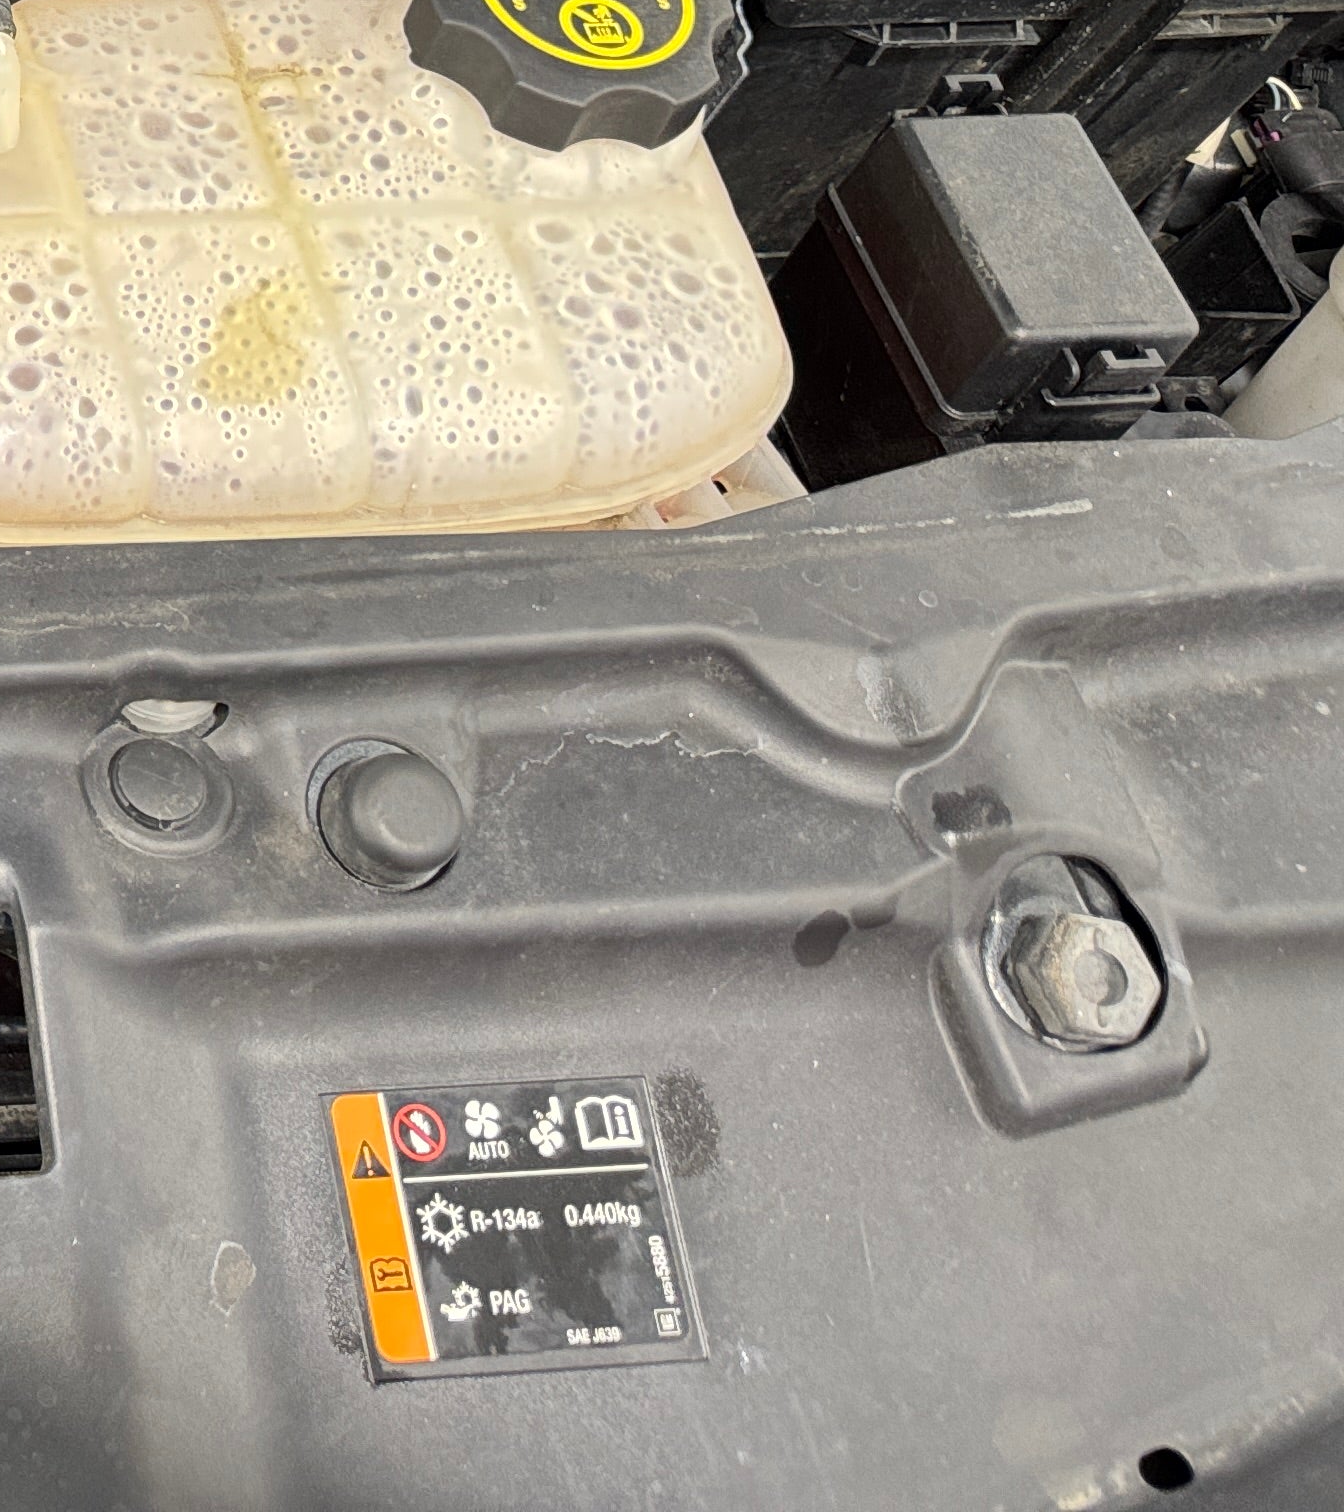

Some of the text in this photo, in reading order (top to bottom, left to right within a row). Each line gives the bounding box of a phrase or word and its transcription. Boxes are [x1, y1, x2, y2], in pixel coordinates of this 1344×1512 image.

[468, 1141, 509, 1161] AUTO
[471, 1202, 642, 1234] R-134a 0.440kg
[489, 1290, 532, 1315] PAG
[566, 1329, 591, 1344] SAE
